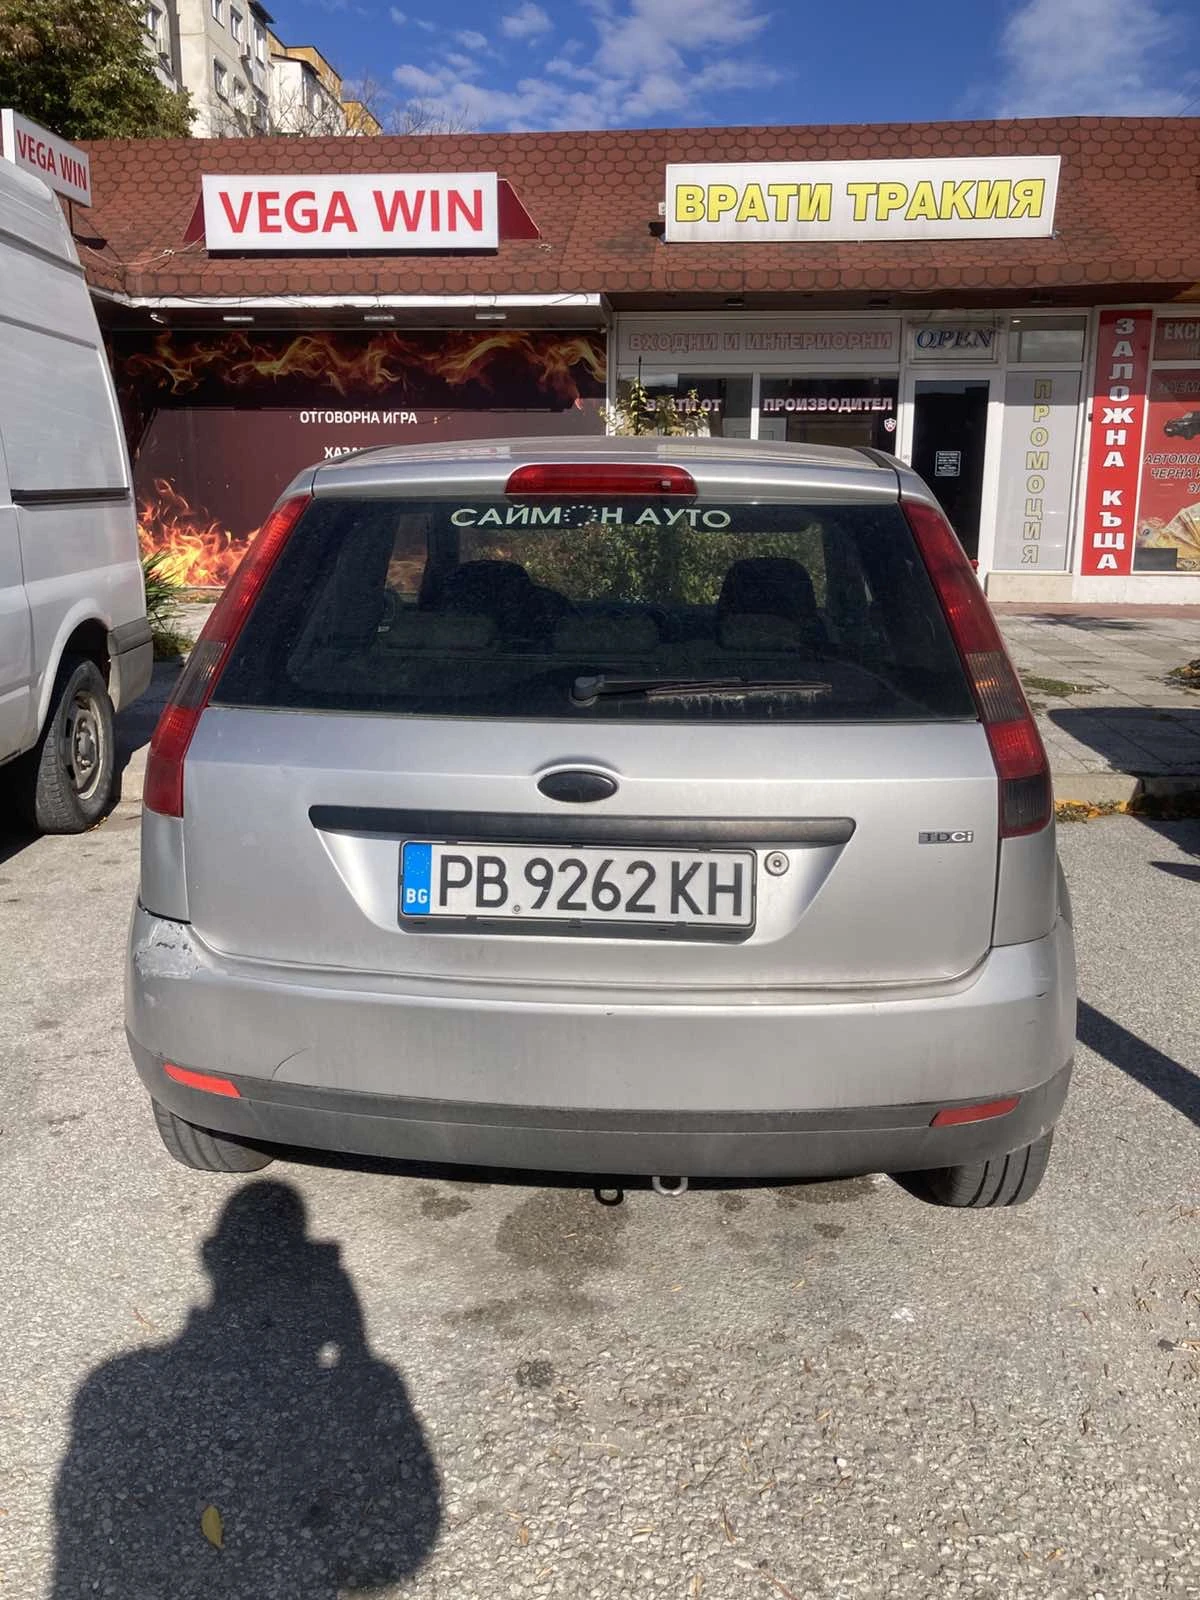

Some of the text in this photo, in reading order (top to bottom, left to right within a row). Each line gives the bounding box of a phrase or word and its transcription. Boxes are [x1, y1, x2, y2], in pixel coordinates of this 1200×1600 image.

[16, 128, 87, 191] VEGA WIN
[218, 189, 483, 233] VEGA WIN
[675, 178, 1046, 222] ВРАТИ ТРАКИЯ
[629, 331, 893, 353] ВХОДНИ И ИНТЕРИОРНИ
[916, 327, 995, 349] OPEN
[701, 398, 722, 412] ОТ
[763, 397, 893, 413] ПРОИЗВОДИТЕЛ
[299, 410, 418, 425] ОТГОВОРНА ИГРА
[1093, 318, 1136, 569] ЗАЛОЖНА КЪЩА
[1021, 379, 1053, 564] ПРОМОЦИЯ
[1151, 468, 1192, 479] ЧЕРНА
[635, 508, 731, 528] АУТО
[919, 831, 973, 843] TDCi
[405, 888, 428, 904] BG
[439, 854, 745, 917] PB 9262 KH
